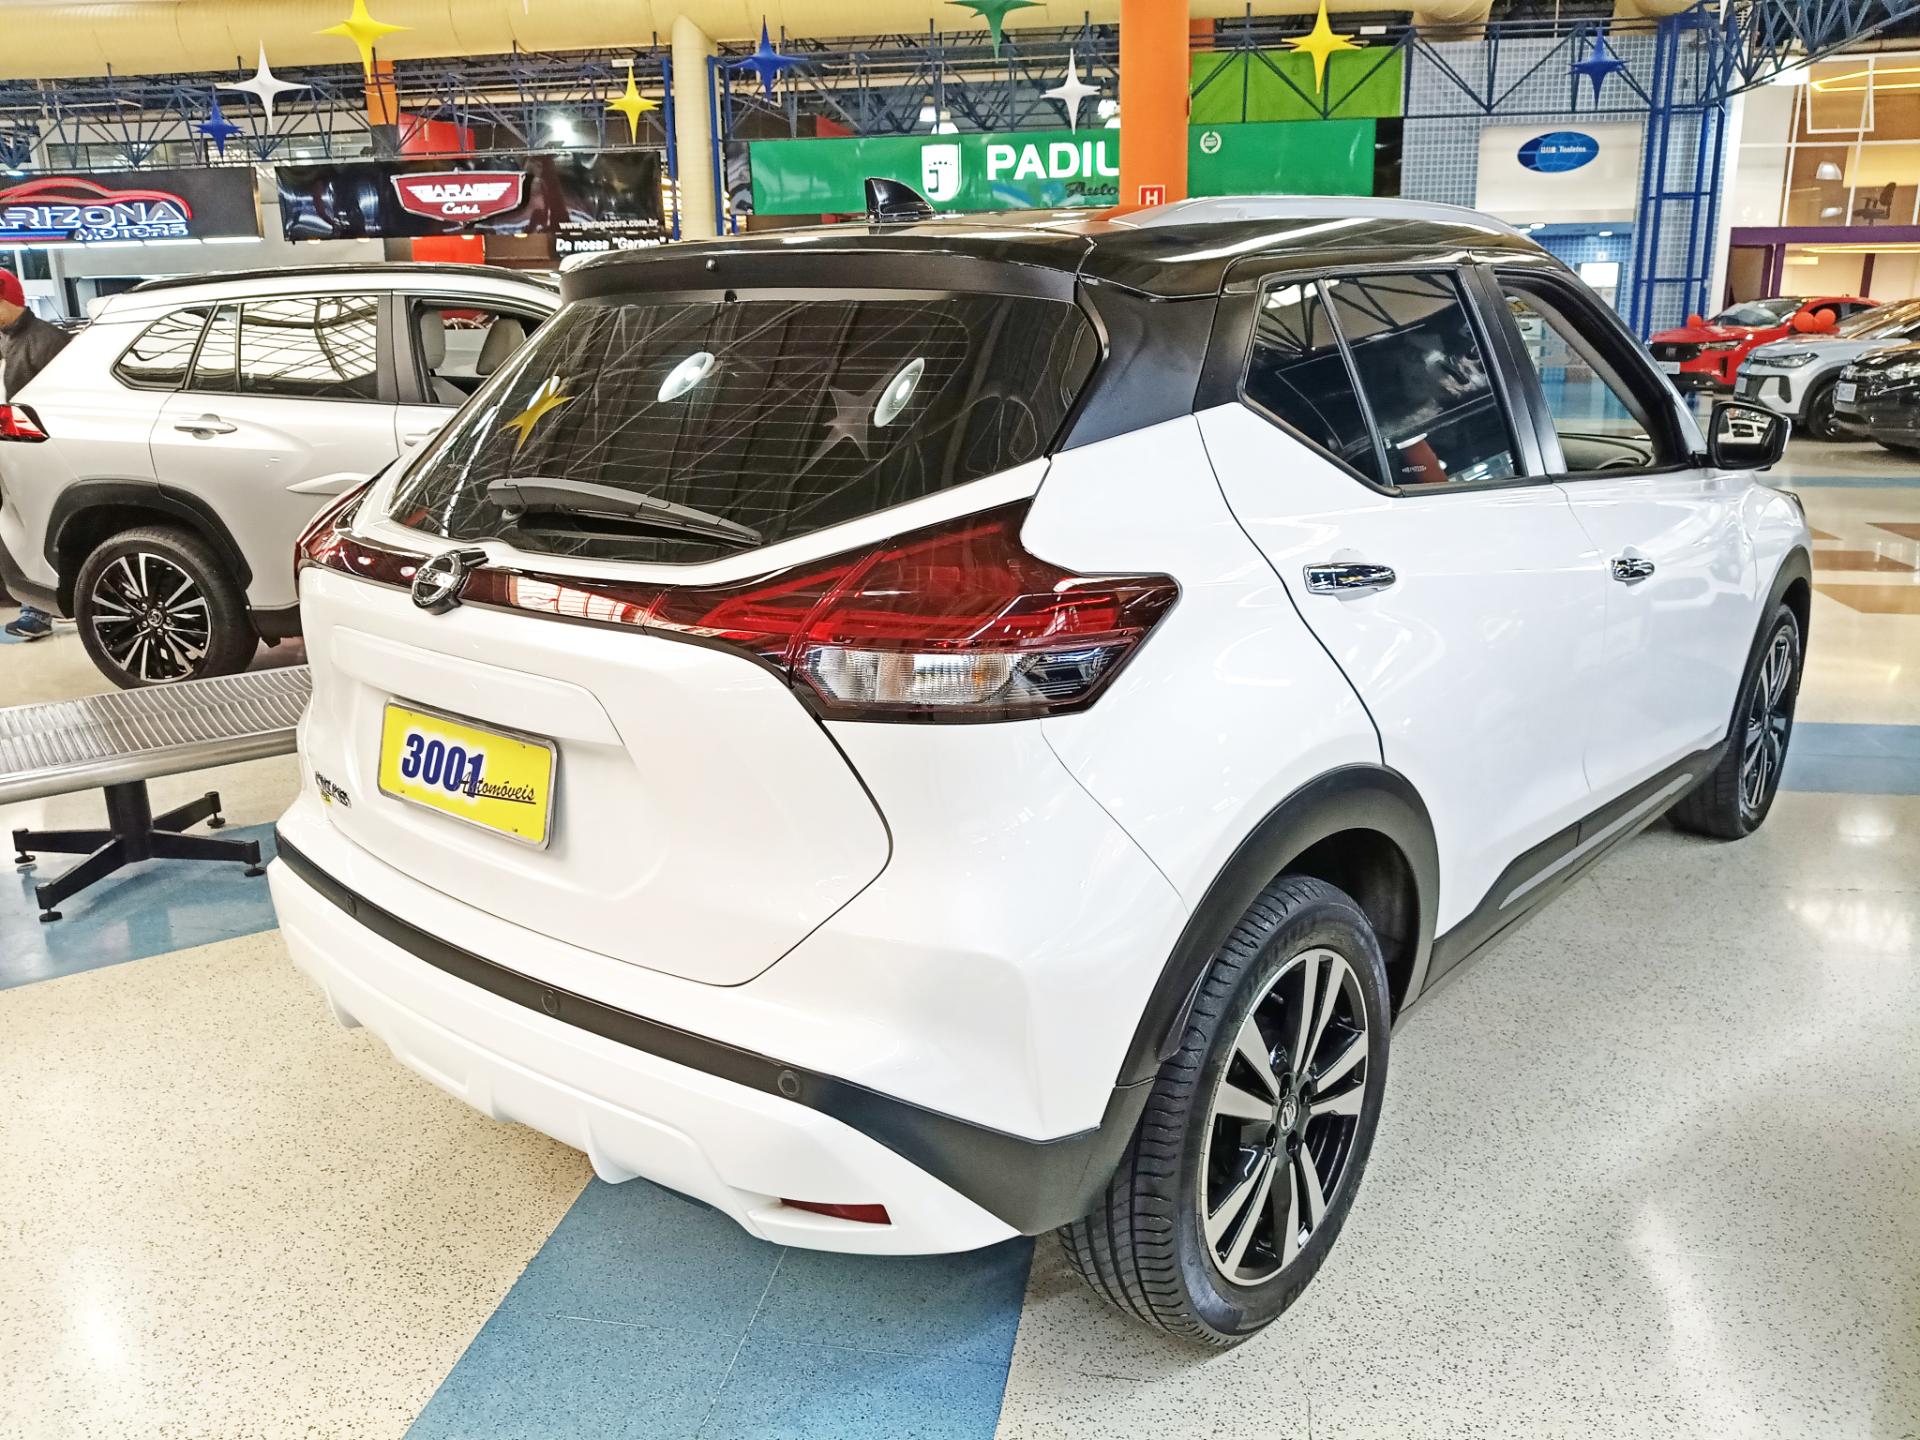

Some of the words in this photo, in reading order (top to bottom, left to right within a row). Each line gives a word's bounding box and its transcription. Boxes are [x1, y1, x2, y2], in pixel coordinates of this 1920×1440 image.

[1145, 190, 1159, 206] H
[0, 201, 187, 229] RIZONA
[441, 202, 481, 215] Cars
[74, 223, 189, 241] MOTORS
[559, 218, 659, 231] www.garagecars.com.br
[574, 239, 610, 252] nossa
[401, 733, 484, 799] 3001
[460, 771, 536, 801] Automóveis
